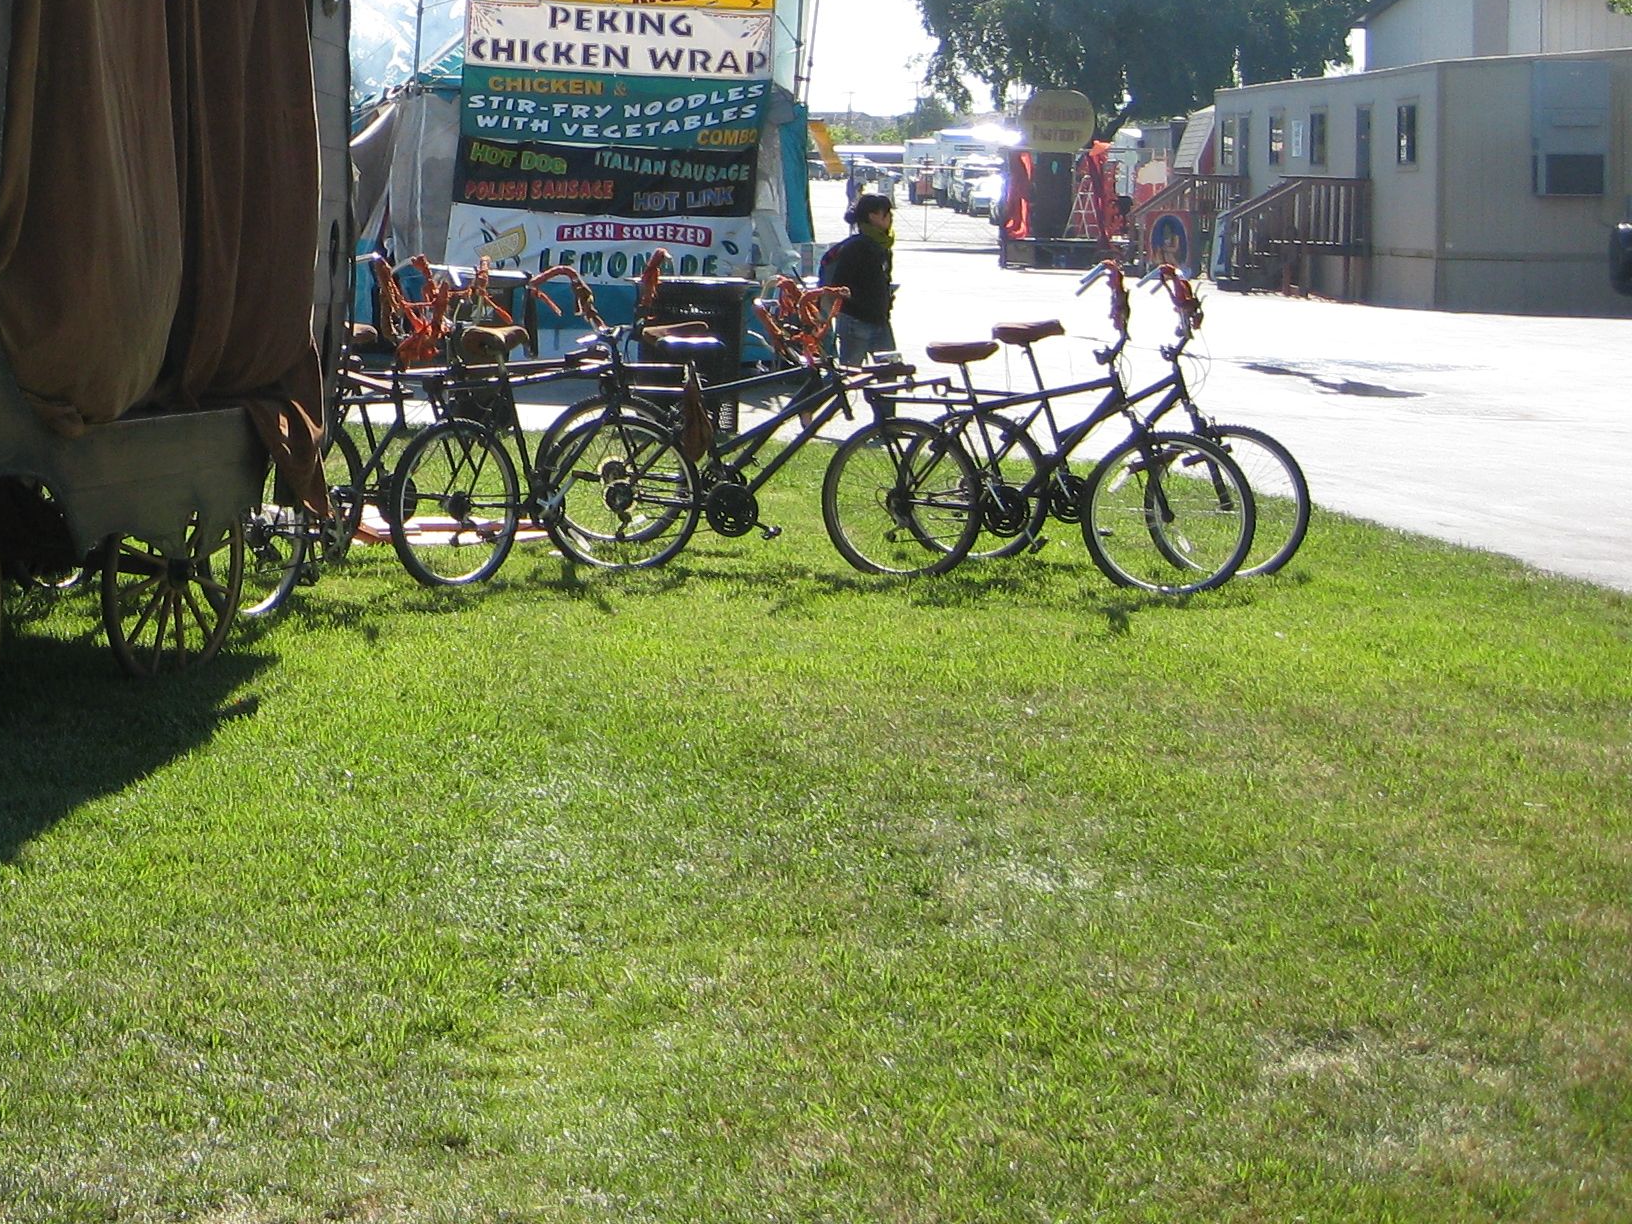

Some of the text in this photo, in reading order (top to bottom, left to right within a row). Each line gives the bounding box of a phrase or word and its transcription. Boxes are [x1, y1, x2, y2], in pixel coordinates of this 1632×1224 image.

[549, 5, 694, 37] PEKING
[471, 38, 768, 73] CHICKEN WRAP
[468, 84, 764, 119] STIR-FRY NOODLES
[488, 76, 604, 95] CHICKEN
[476, 103, 758, 139] WITH VEGETABLES
[696, 129, 757, 146] COMBO
[469, 142, 568, 174] HOT DOG
[594, 150, 750, 182] ITALIAN SAUSAGE
[464, 179, 614, 201] POLISH SAUSAGE
[633, 186, 735, 213] HOT LINK
[563, 223, 707, 243] FRESH SQUEEZED
